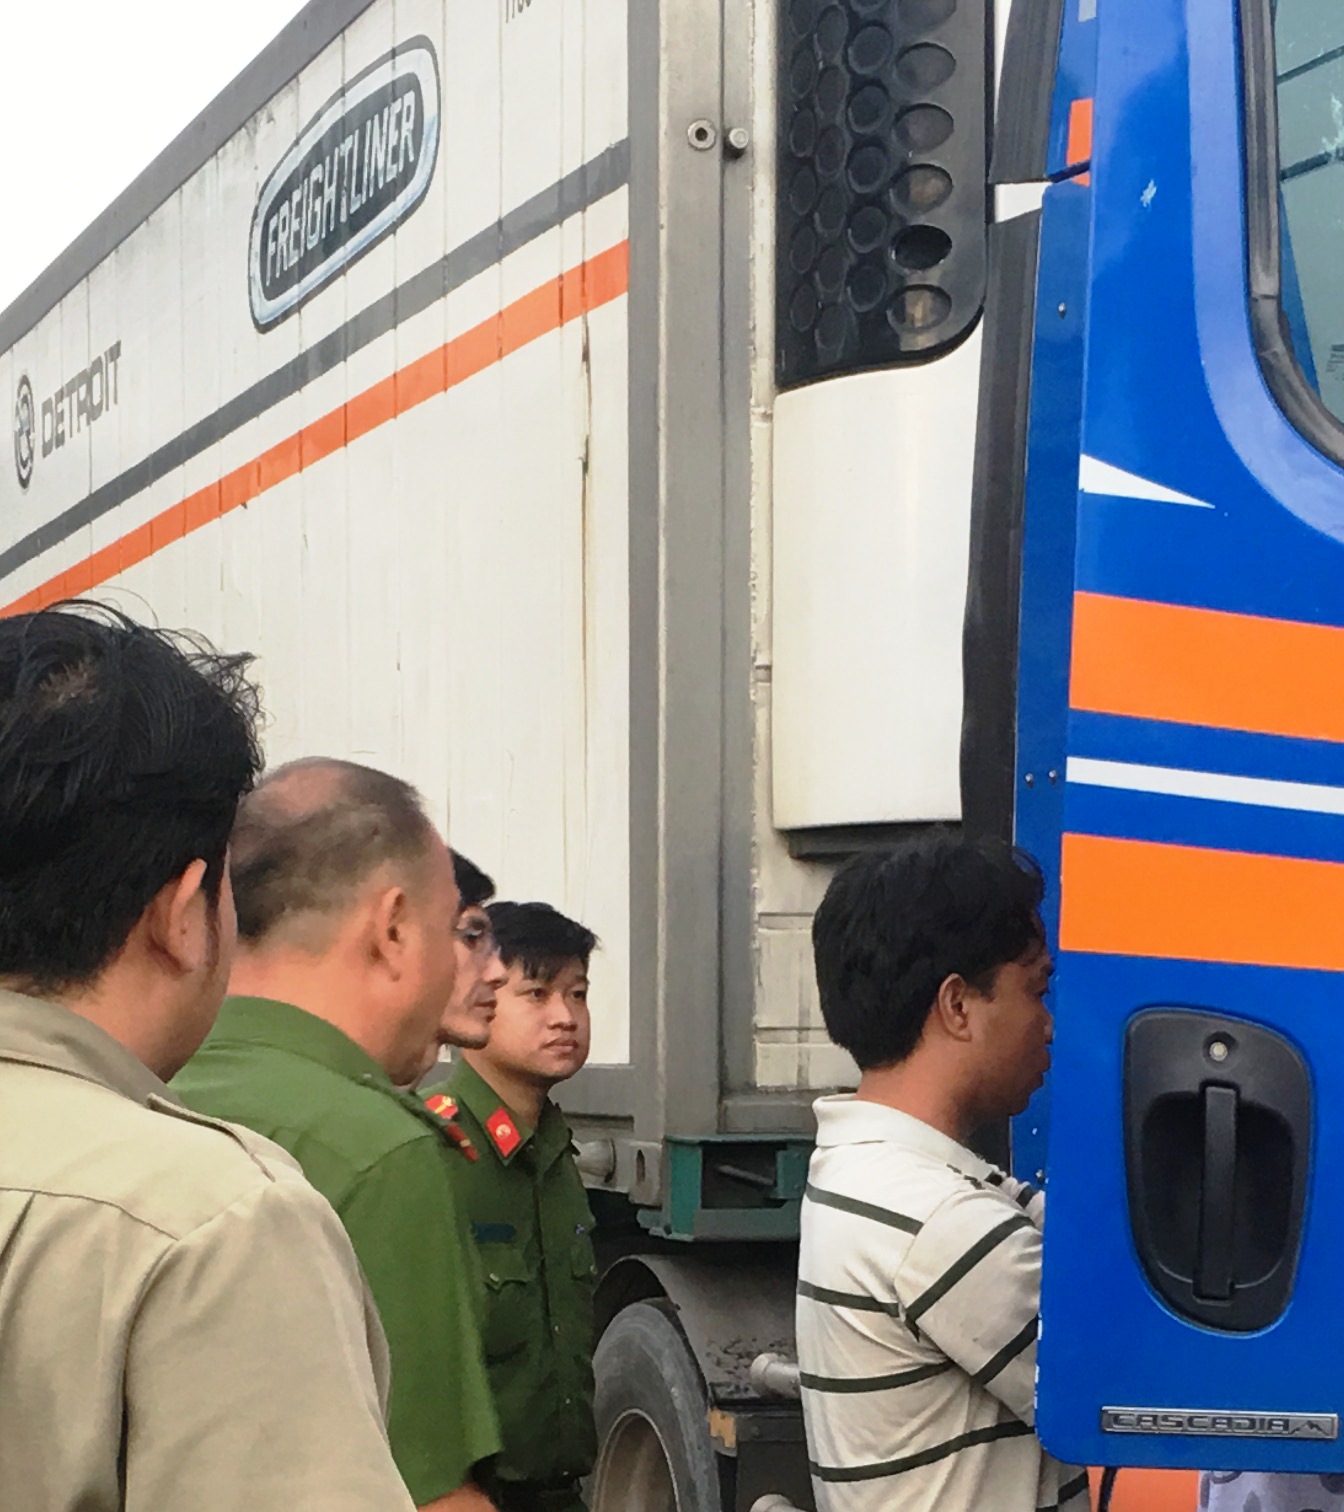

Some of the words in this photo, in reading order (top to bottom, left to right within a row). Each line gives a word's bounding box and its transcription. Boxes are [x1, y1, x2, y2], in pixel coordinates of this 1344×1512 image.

[265, 89, 416, 287] FREIGHTLINER
[41, 340, 122, 458] DETROIT
[1112, 1412, 1290, 1432] CASCADIA
